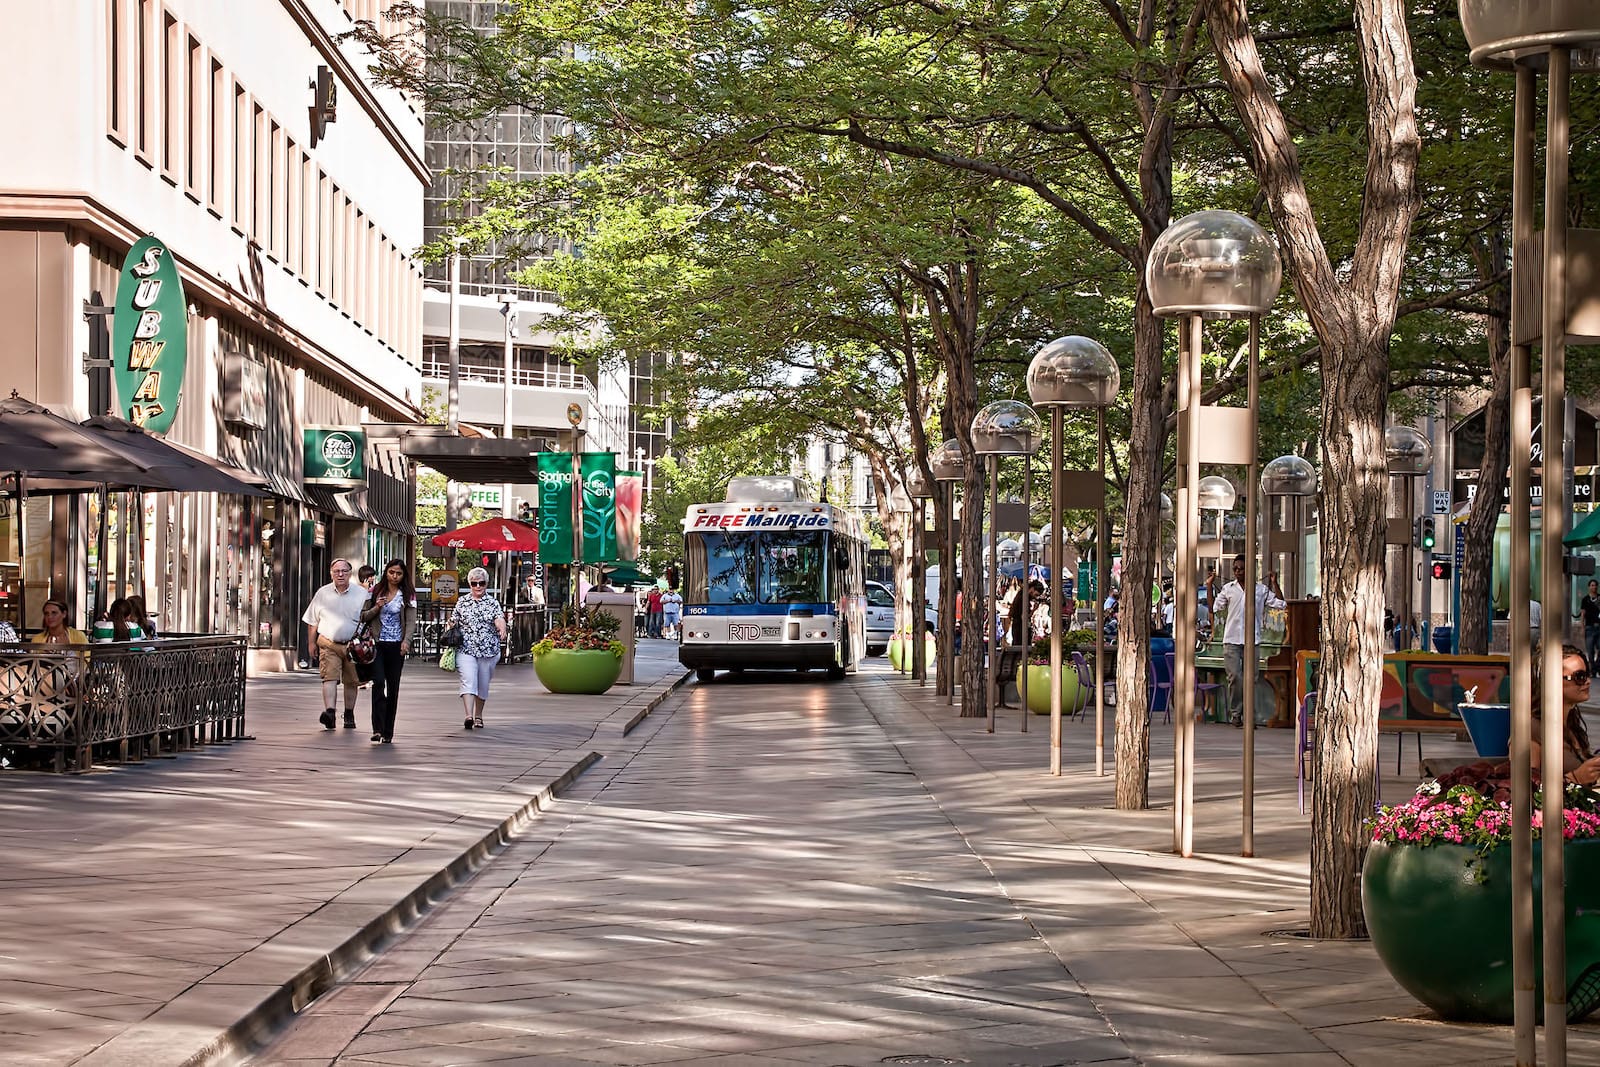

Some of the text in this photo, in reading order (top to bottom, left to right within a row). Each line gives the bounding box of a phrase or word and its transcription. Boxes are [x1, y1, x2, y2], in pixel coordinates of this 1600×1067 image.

[129, 246, 167, 428] SUBWAY
[326, 438, 352, 449] The
[323, 468, 352, 478] ATM
[538, 471, 572, 483] Spring
[591, 480, 605, 488] the
[471, 491, 499, 503] FFEE
[596, 487, 614, 498] city
[694, 514, 828, 527] FREE MallRide
[729, 624, 761, 640] RTD
